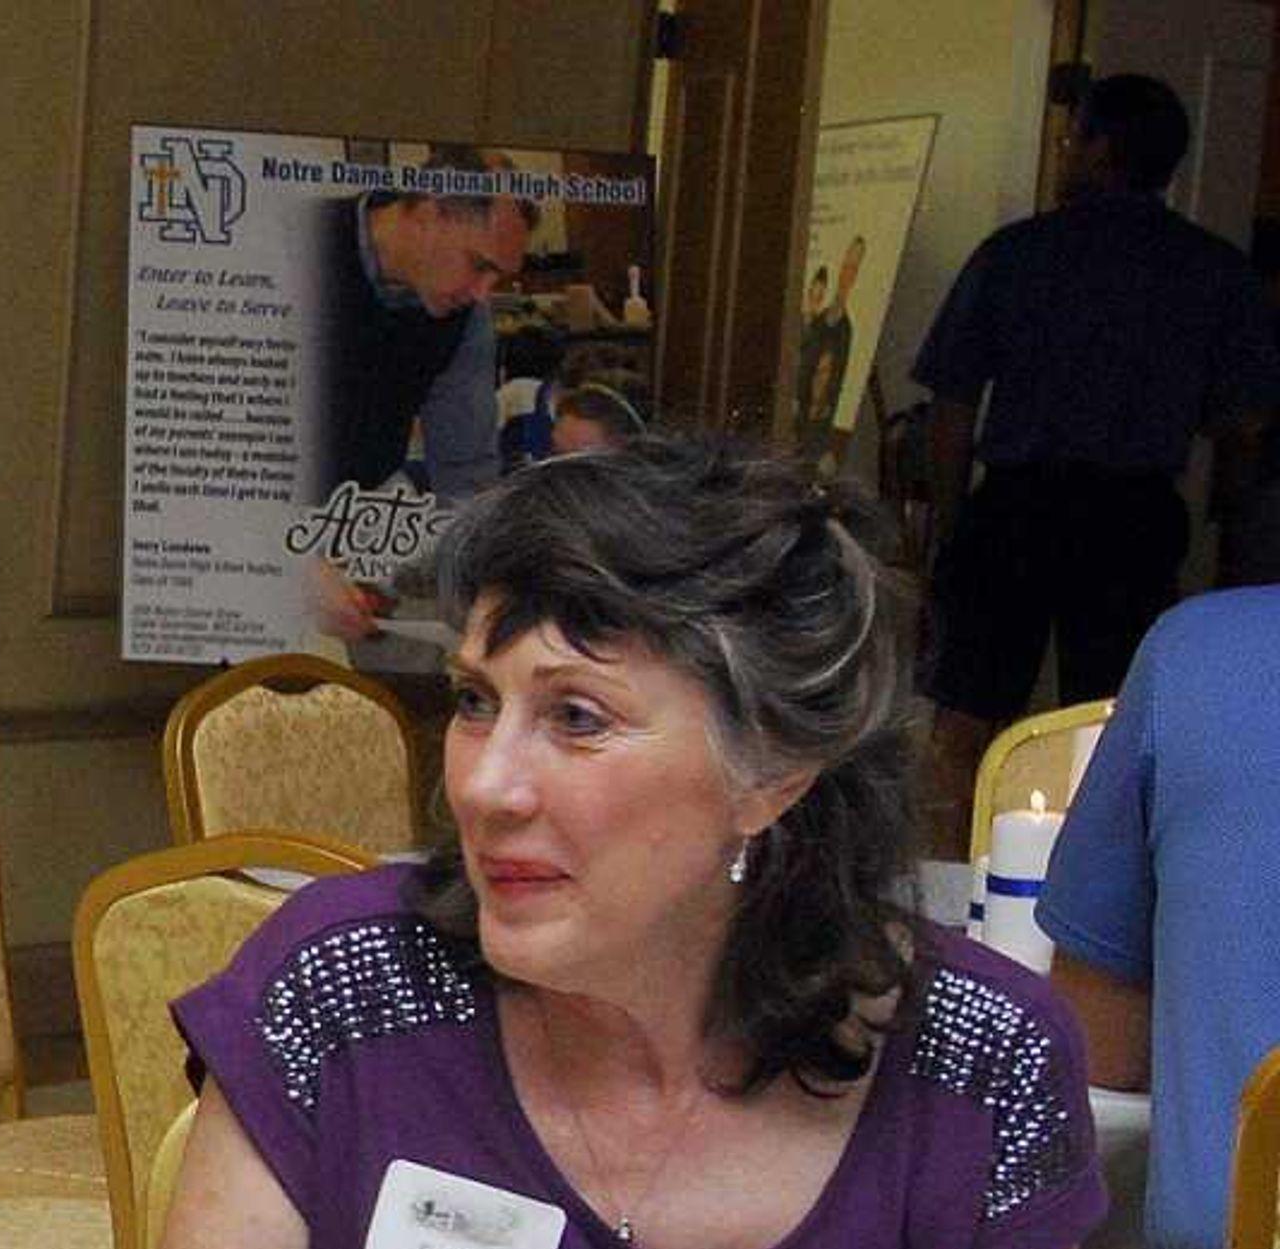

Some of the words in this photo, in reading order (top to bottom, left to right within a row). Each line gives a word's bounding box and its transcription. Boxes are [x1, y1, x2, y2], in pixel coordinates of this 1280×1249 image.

[262, 156, 324, 184] Notre
[331, 160, 395, 189] Dame
[401, 166, 502, 197] Regional
[509, 172, 562, 200] High
[564, 174, 649, 205] School
[138, 265, 188, 285] Enter
[194, 269, 214, 285] to
[155, 292, 212, 313] Leave
[215, 299, 237, 314] to
[240, 299, 293, 319] Serve
